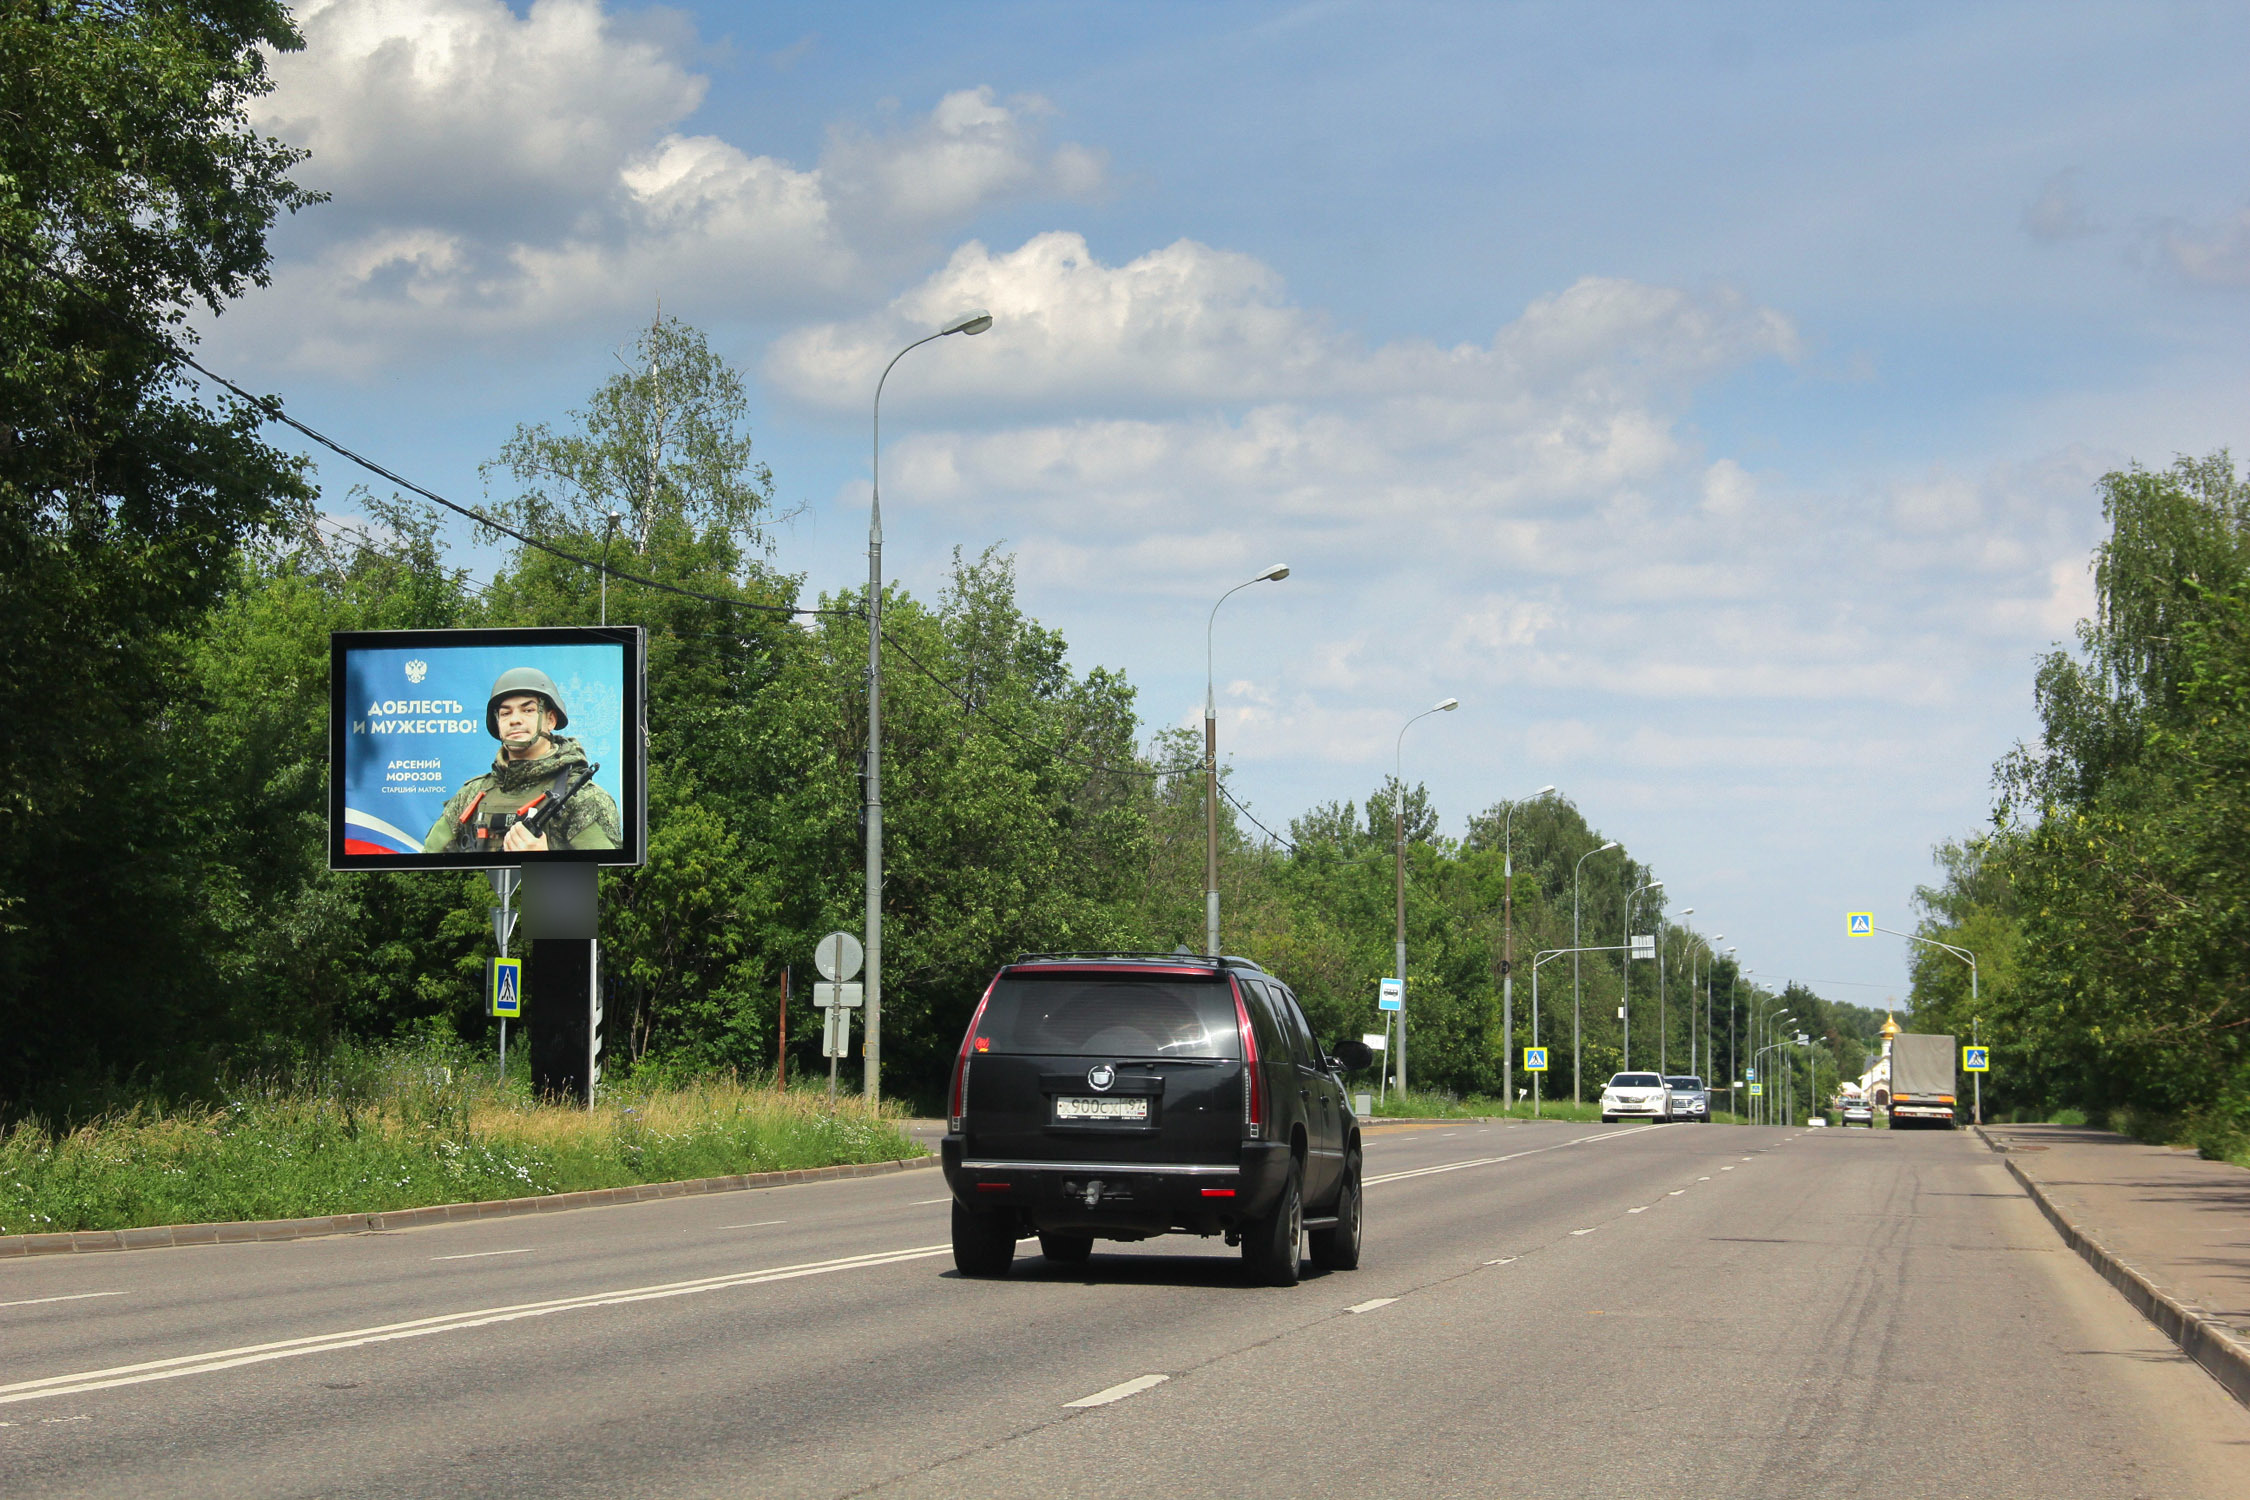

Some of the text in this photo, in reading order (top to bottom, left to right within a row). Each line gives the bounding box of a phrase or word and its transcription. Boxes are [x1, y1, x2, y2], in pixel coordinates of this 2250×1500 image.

[367, 700, 463, 716] ДОБЛЕСТЬ
[353, 719, 478, 734] И МУЖЕСТВО!
[387, 758, 441, 769] АРСЕНИЙ
[386, 772, 442, 781] МОРОЗОВ
[381, 785, 417, 793] СТАРШИЙ
